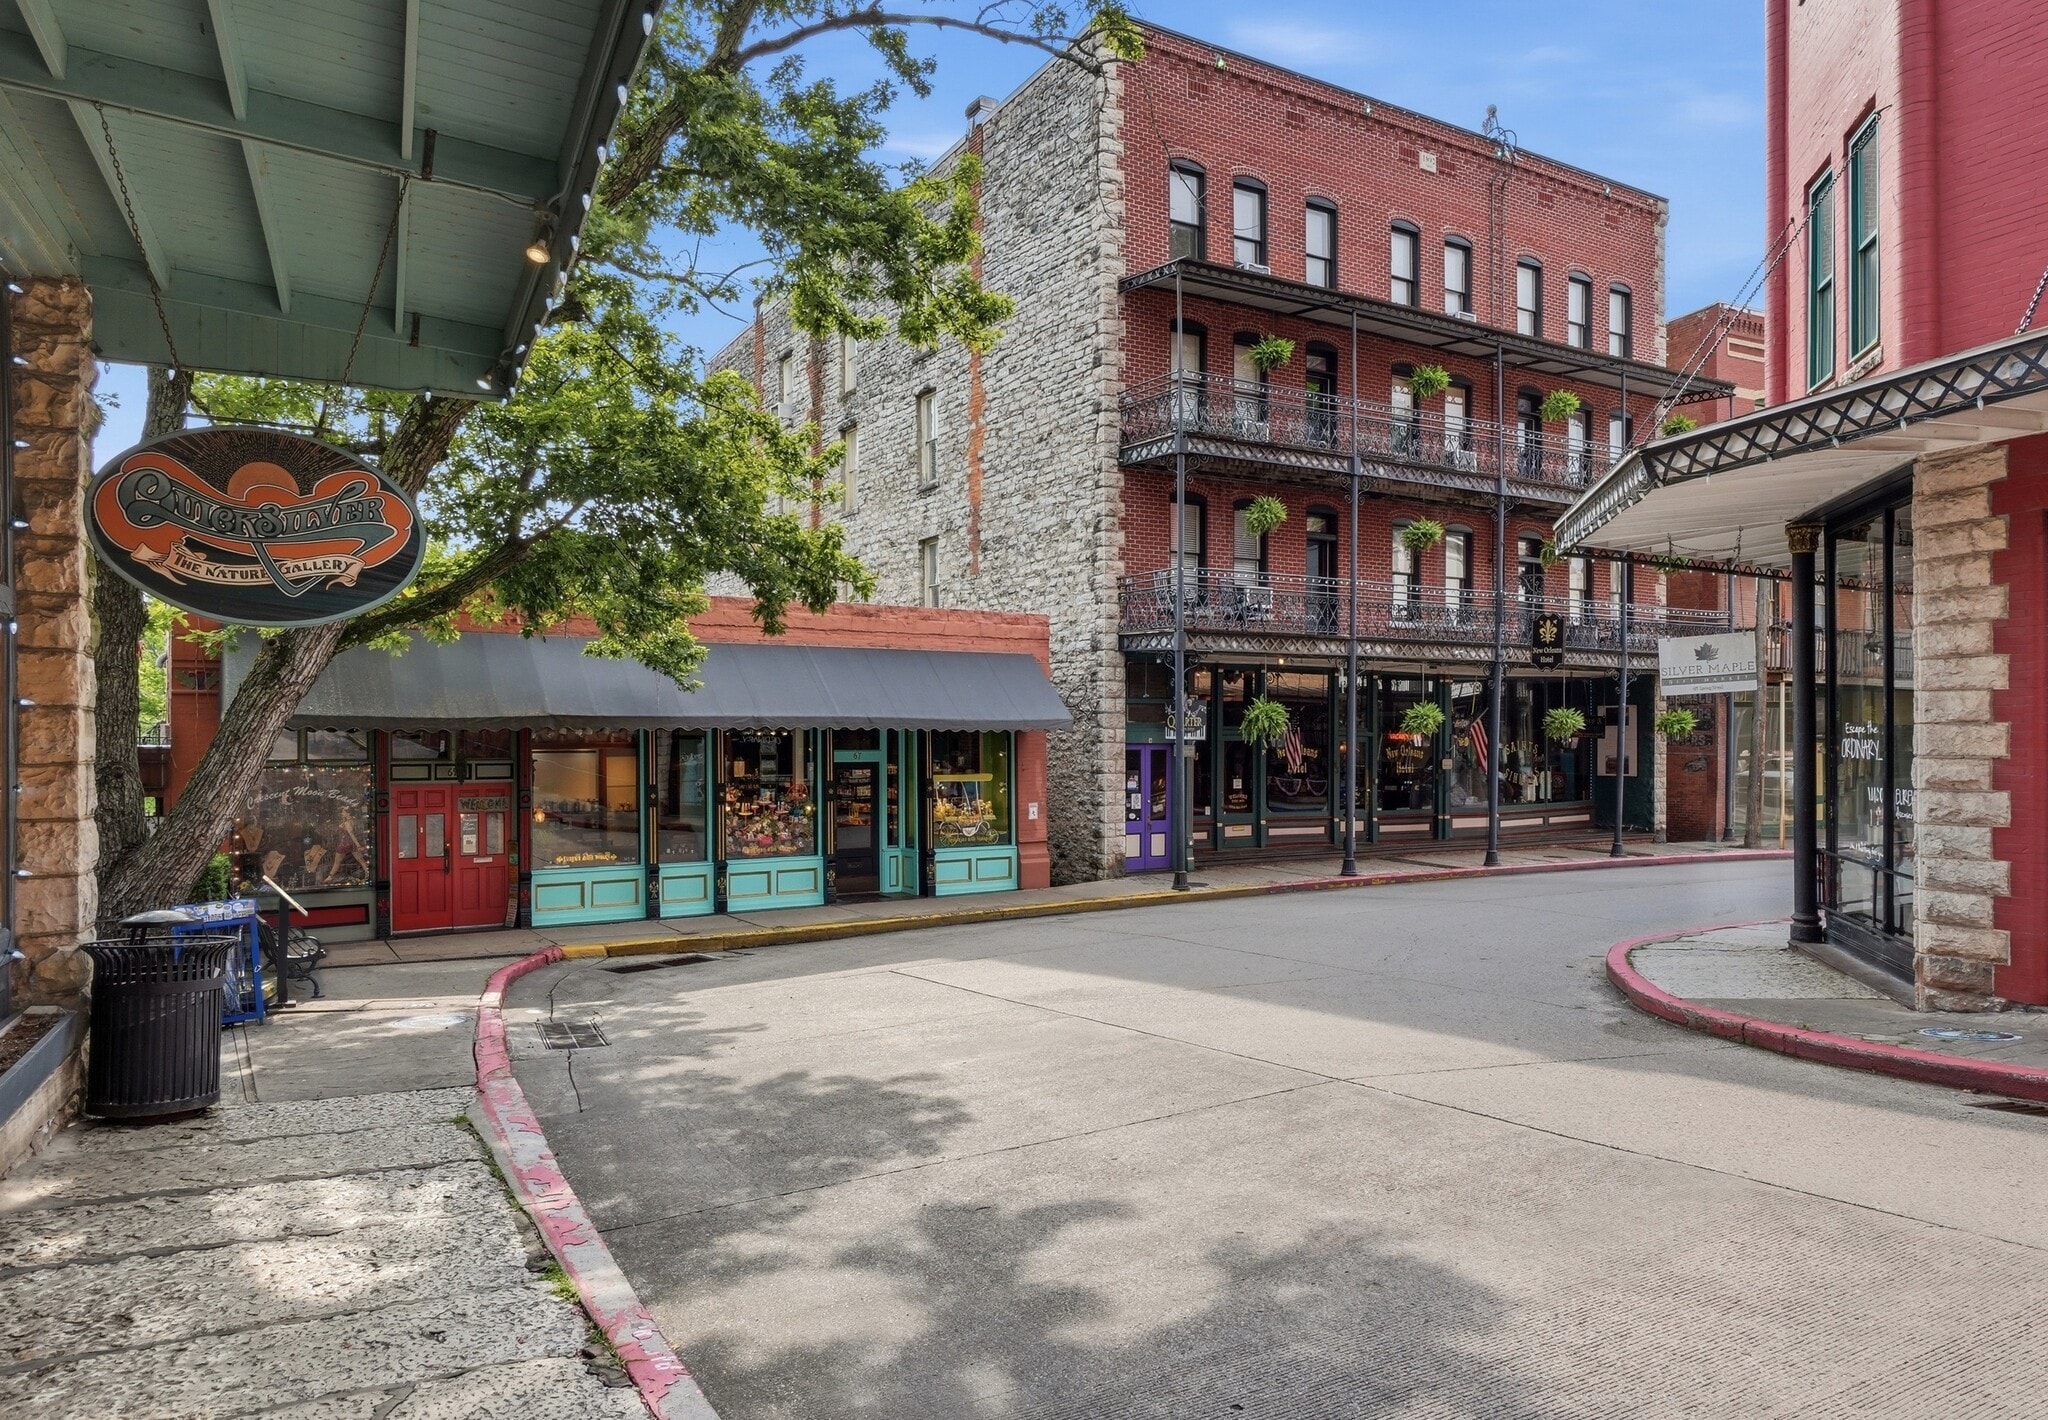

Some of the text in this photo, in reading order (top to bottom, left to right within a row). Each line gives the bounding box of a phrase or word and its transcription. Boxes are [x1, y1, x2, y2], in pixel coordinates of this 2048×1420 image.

[116, 468, 386, 541] QUICKSILVER
[173, 552, 357, 580] THE NATURE GALLERY
[1661, 661, 1755, 677] SILVER MAPLE
[1167, 714, 1202, 730] QRTER
[1845, 720, 1879, 739] Escape the
[1504, 740, 1539, 755] SAINTS
[853, 752, 861, 760] 67
[1504, 768, 1540, 785] SINS
[293, 786, 325, 797] Moon
